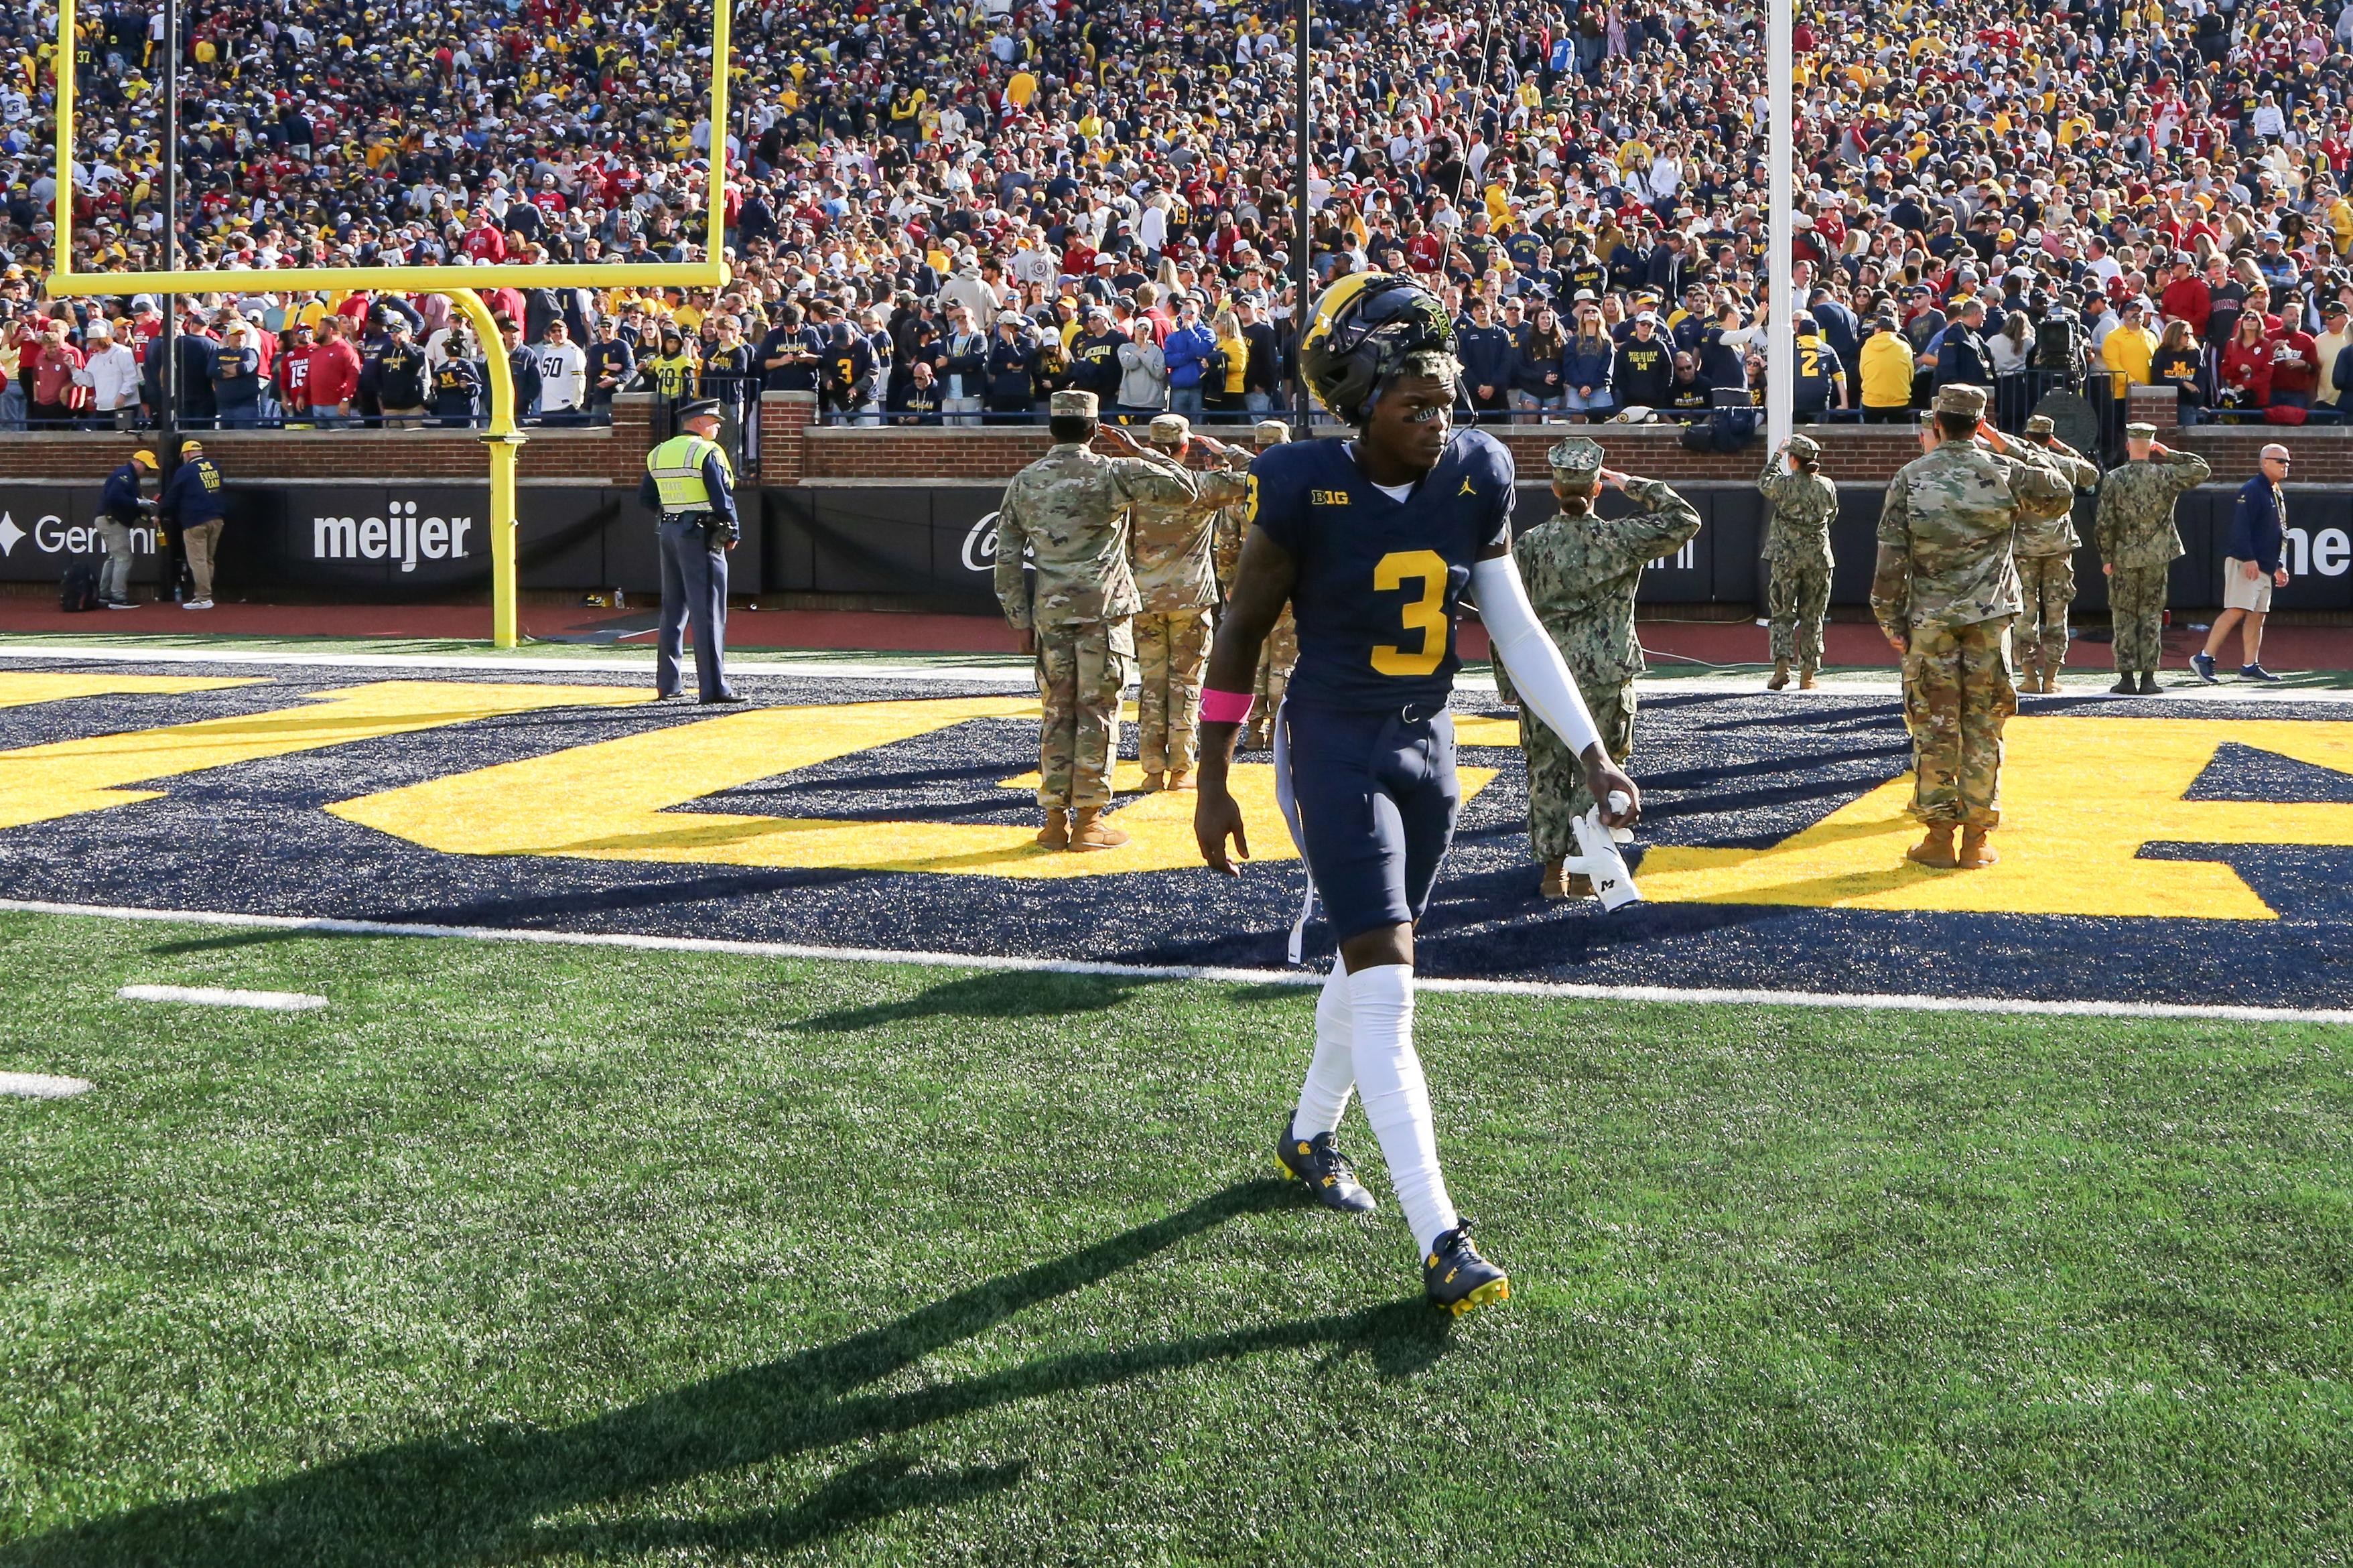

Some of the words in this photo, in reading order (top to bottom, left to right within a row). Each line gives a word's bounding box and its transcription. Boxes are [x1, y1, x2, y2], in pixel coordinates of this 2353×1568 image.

[77, 51, 90, 64] 37
[1085, 345, 1111, 357] MICHIGAN
[1800, 350, 1819, 377] 2
[2173, 361, 2187, 371] M
[291, 365, 309, 388] 15
[440, 371, 455, 384] M
[837, 358, 852, 384] 3
[200, 470, 220, 481] EVENT
[203, 478, 220, 489] TEAM
[661, 482, 682, 491] STATE
[661, 492, 687, 502] POLICE
[1243, 473, 1260, 523] 3
[314, 500, 472, 573] meijer
[1371, 549, 1449, 676] 3
[1601, 879, 1615, 892] M
